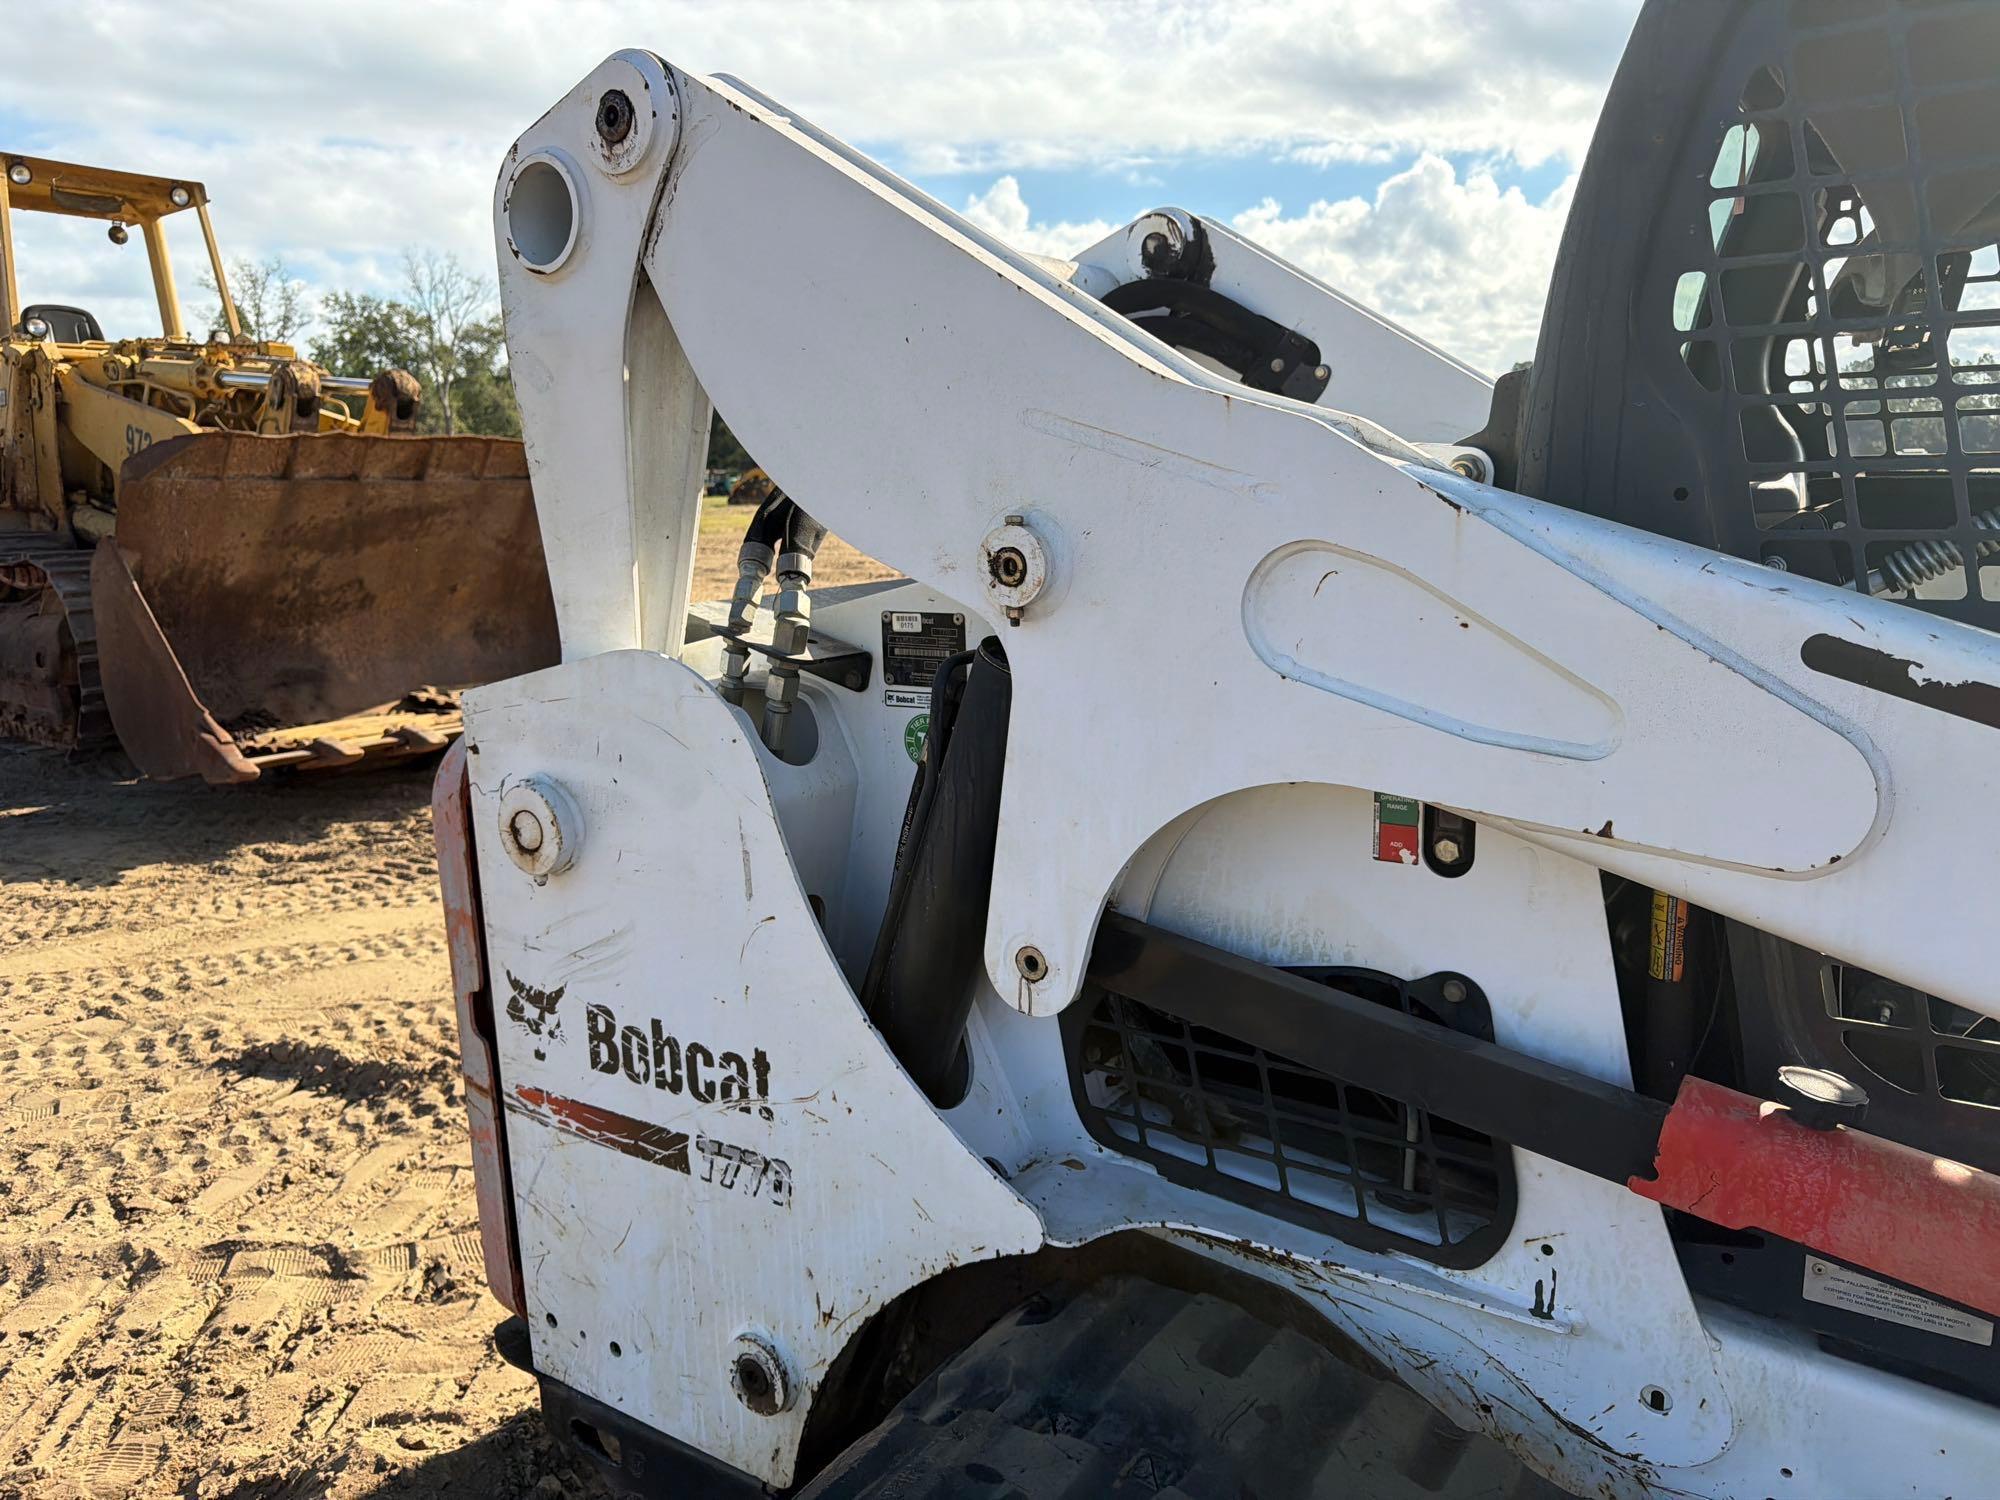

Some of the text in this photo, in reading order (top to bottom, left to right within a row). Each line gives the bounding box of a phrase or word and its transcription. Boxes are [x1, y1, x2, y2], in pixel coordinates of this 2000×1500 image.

[896, 695, 916, 704] Bobcat
[910, 717, 925, 730] TIER
[1386, 803, 1408, 811] RANGE
[1674, 925, 1684, 966] WARNING
[586, 1003, 774, 1122] Bobcat
